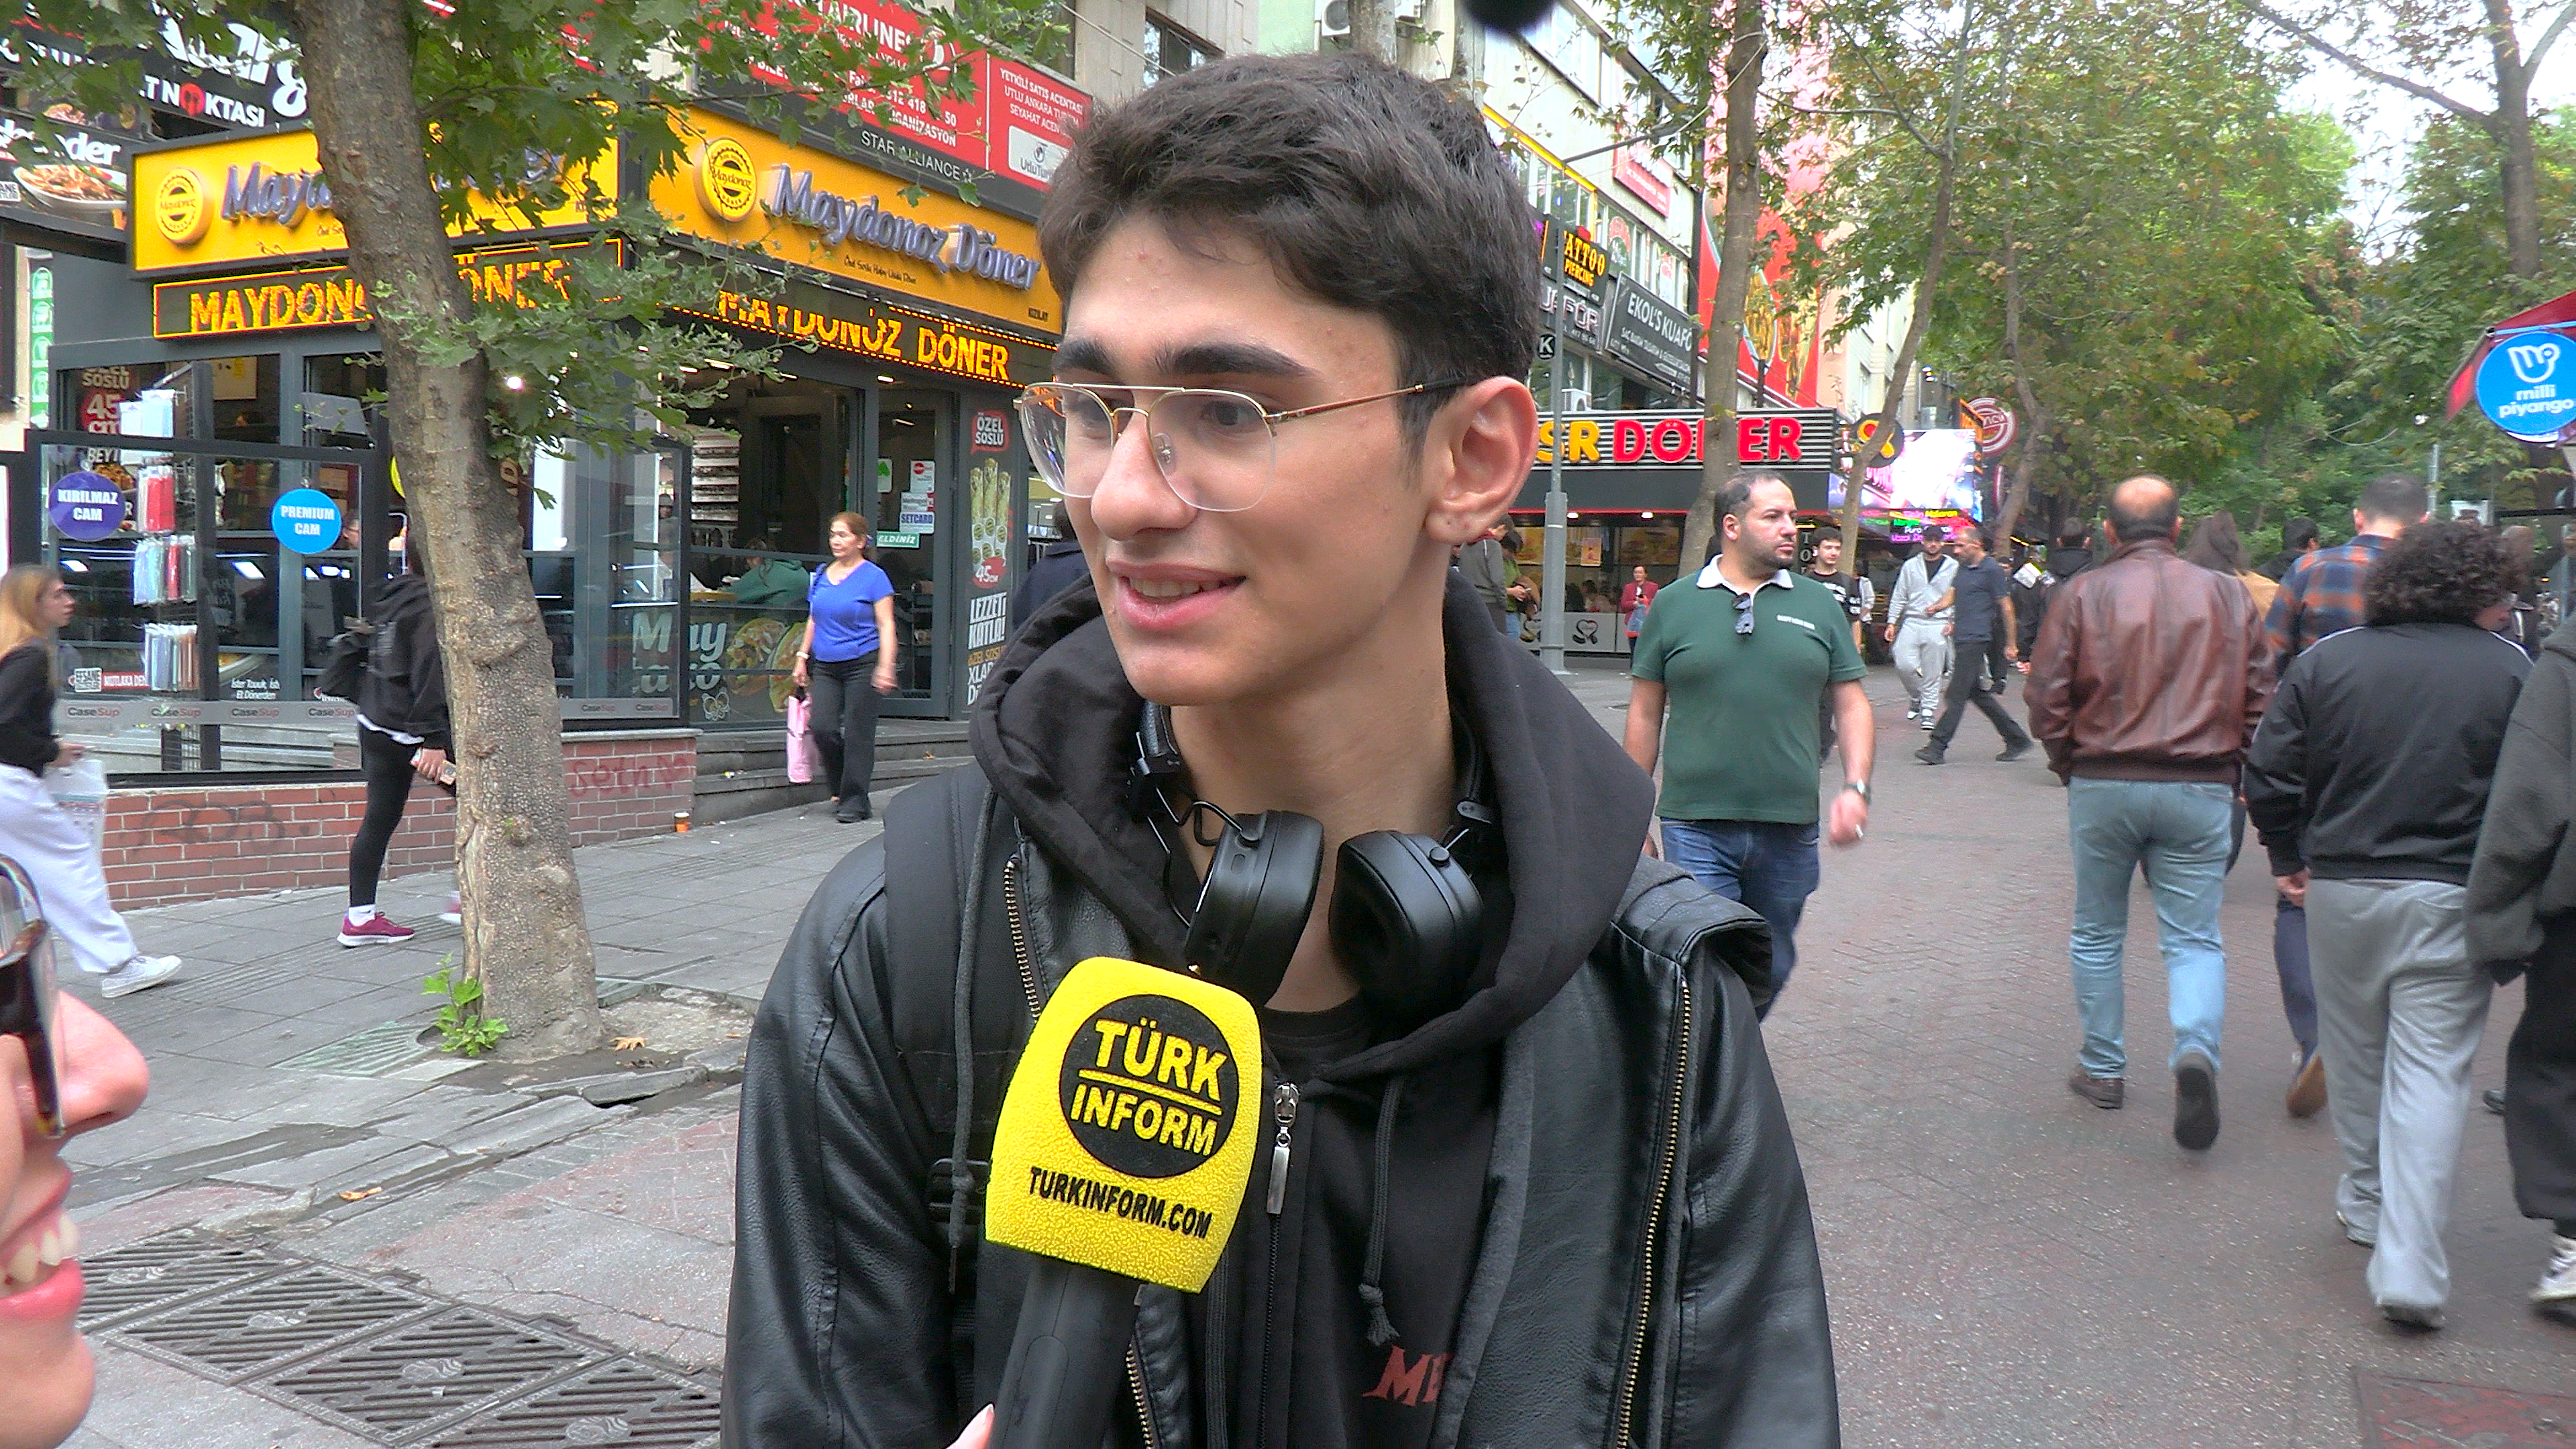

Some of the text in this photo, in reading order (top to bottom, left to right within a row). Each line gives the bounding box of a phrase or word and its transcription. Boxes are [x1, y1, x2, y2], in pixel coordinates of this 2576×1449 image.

[1000, 68, 1028, 90] YETKİLİ
[1029, 82, 1049, 101] SATIŞ
[908, 97, 926, 114] 418
[1004, 85, 1024, 101] UTLU
[1024, 95, 1053, 116] ANKARA
[1010, 103, 1040, 125] SEYAHAT
[861, 130, 896, 156] STAR
[772, 163, 1041, 290] Maydonoz Döner
[1564, 230, 1607, 276] ATTOO
[191, 276, 367, 333] MAYDON
[1661, 315, 1693, 352] KUAFÖ
[918, 321, 1010, 380] DÖNER
[81, 371, 129, 389] SOSLU
[2516, 384, 2555, 400] milli
[86, 393, 120, 419] 45
[2499, 398, 2575, 419] piyango
[976, 411, 1004, 433] ÖZEL
[975, 431, 1004, 446] SOSLU
[1536, 419, 1600, 463] SR
[57, 488, 119, 506] KIRILMAZ
[72, 506, 103, 521] CAM
[280, 505, 335, 521] PREMIUM
[294, 522, 321, 535] CAM
[68, 706, 120, 718] CaseSup
[231, 707, 280, 718] CaseSup
[308, 707, 355, 717] CaseSup
[1095, 1016, 1228, 1102] TÜRK
[1069, 1082, 1220, 1157] INFORM
[1029, 1166, 1213, 1239] TURKINFORM.COM
